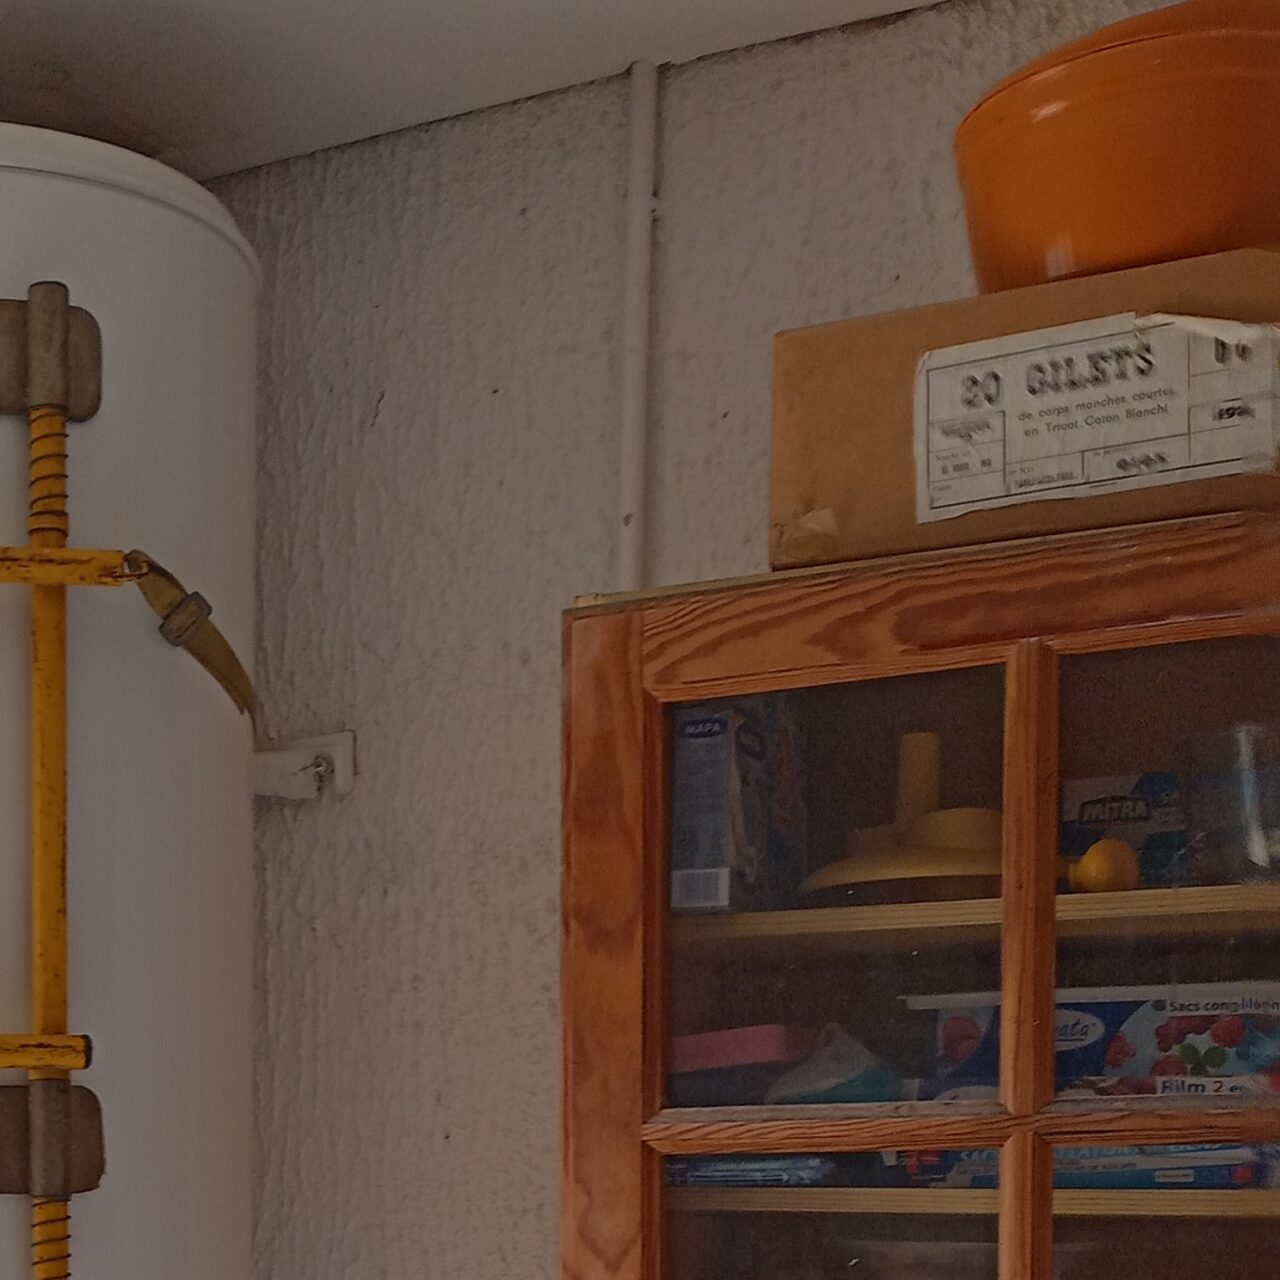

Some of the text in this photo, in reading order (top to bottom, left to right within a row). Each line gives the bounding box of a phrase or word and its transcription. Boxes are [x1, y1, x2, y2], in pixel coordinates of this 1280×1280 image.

[960, 370, 1003, 410] 20
[1017, 411, 1033, 422] de
[1212, 1080, 1224, 1094] 2
